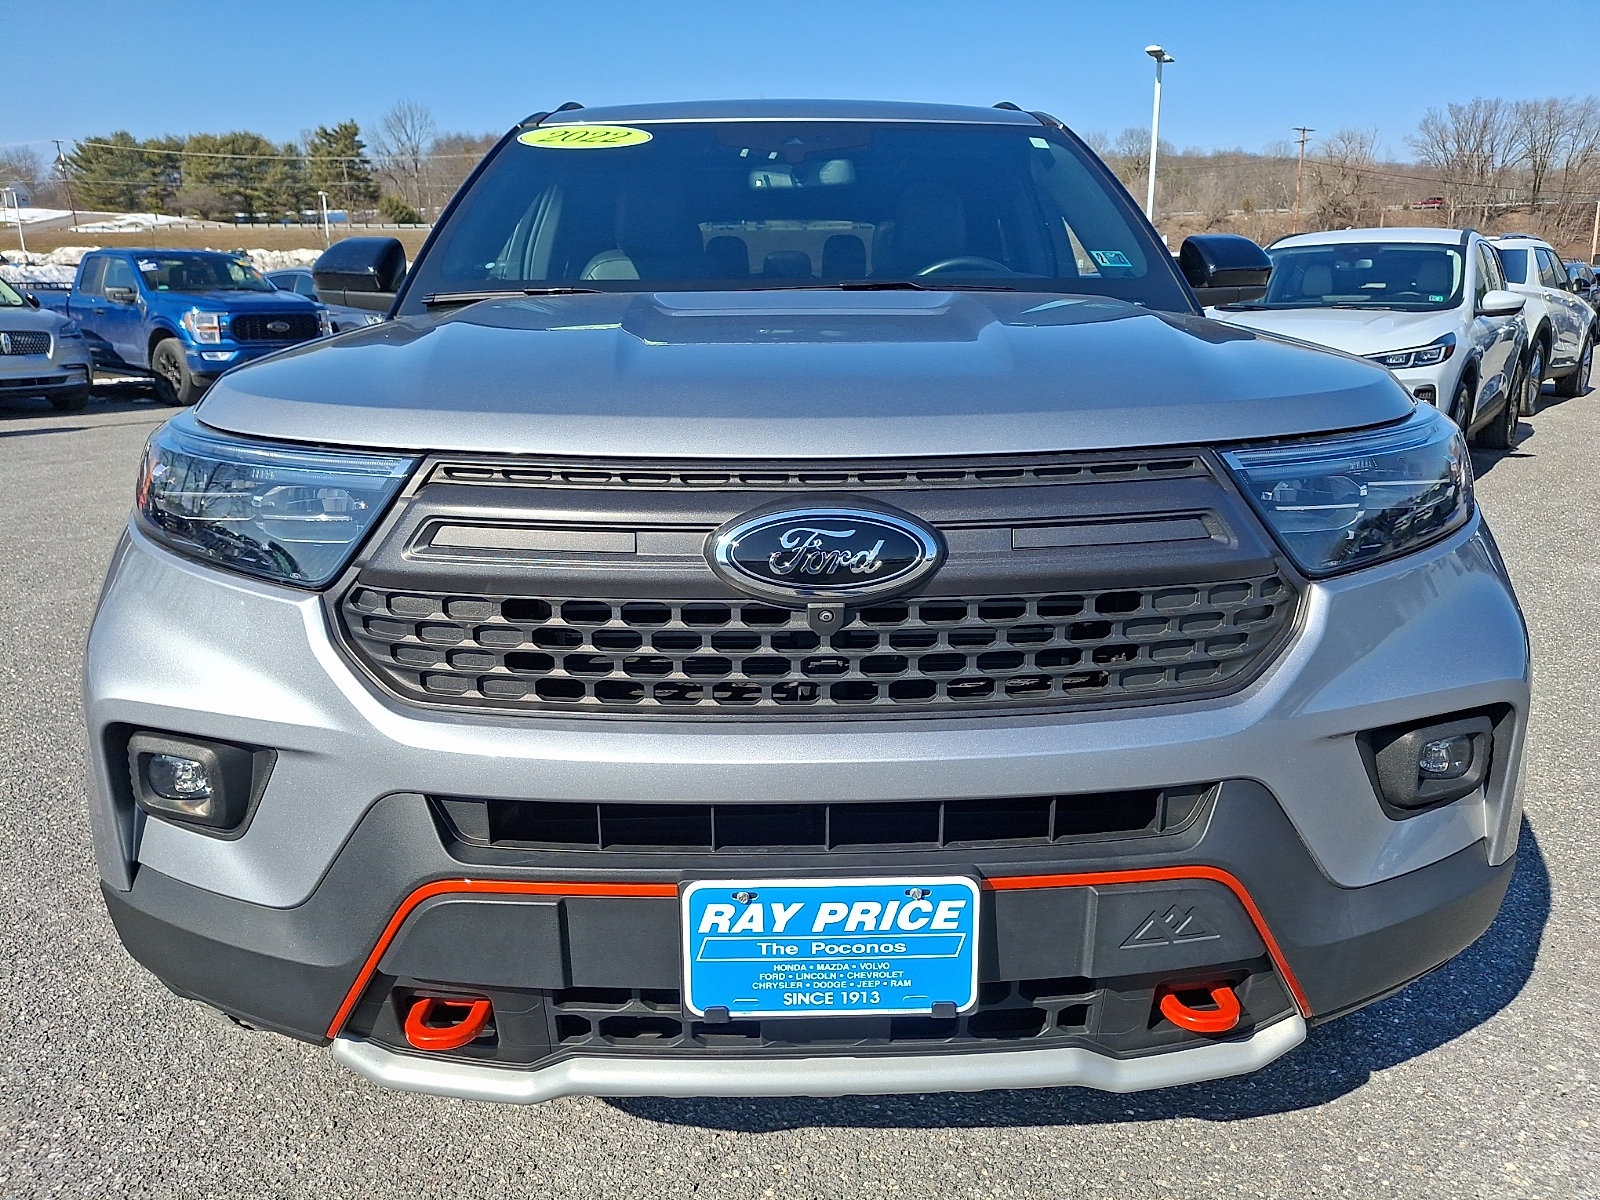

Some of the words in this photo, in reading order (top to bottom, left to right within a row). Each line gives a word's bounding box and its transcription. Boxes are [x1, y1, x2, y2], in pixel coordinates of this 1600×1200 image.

[537, 130, 633, 143] 2022
[768, 527, 885, 575] Ford
[697, 903, 805, 933] RAY
[811, 899, 967, 932] PRICE
[757, 942, 799, 955] The
[811, 942, 907, 955] Poconos
[773, 963, 807, 972] HONDA
[816, 963, 850, 971] MAZDA
[859, 962, 891, 970] VOLVO
[759, 973, 786, 981] FORD
[795, 972, 837, 980] LINCOLN
[846, 971, 904, 979] CHEVROLET
[752, 982, 803, 990] CHRYSLER
[813, 981, 847, 989] DODGE
[890, 979, 912, 987] RAM
[783, 992, 834, 1006] SINCE
[841, 991, 881, 1005] 1913
